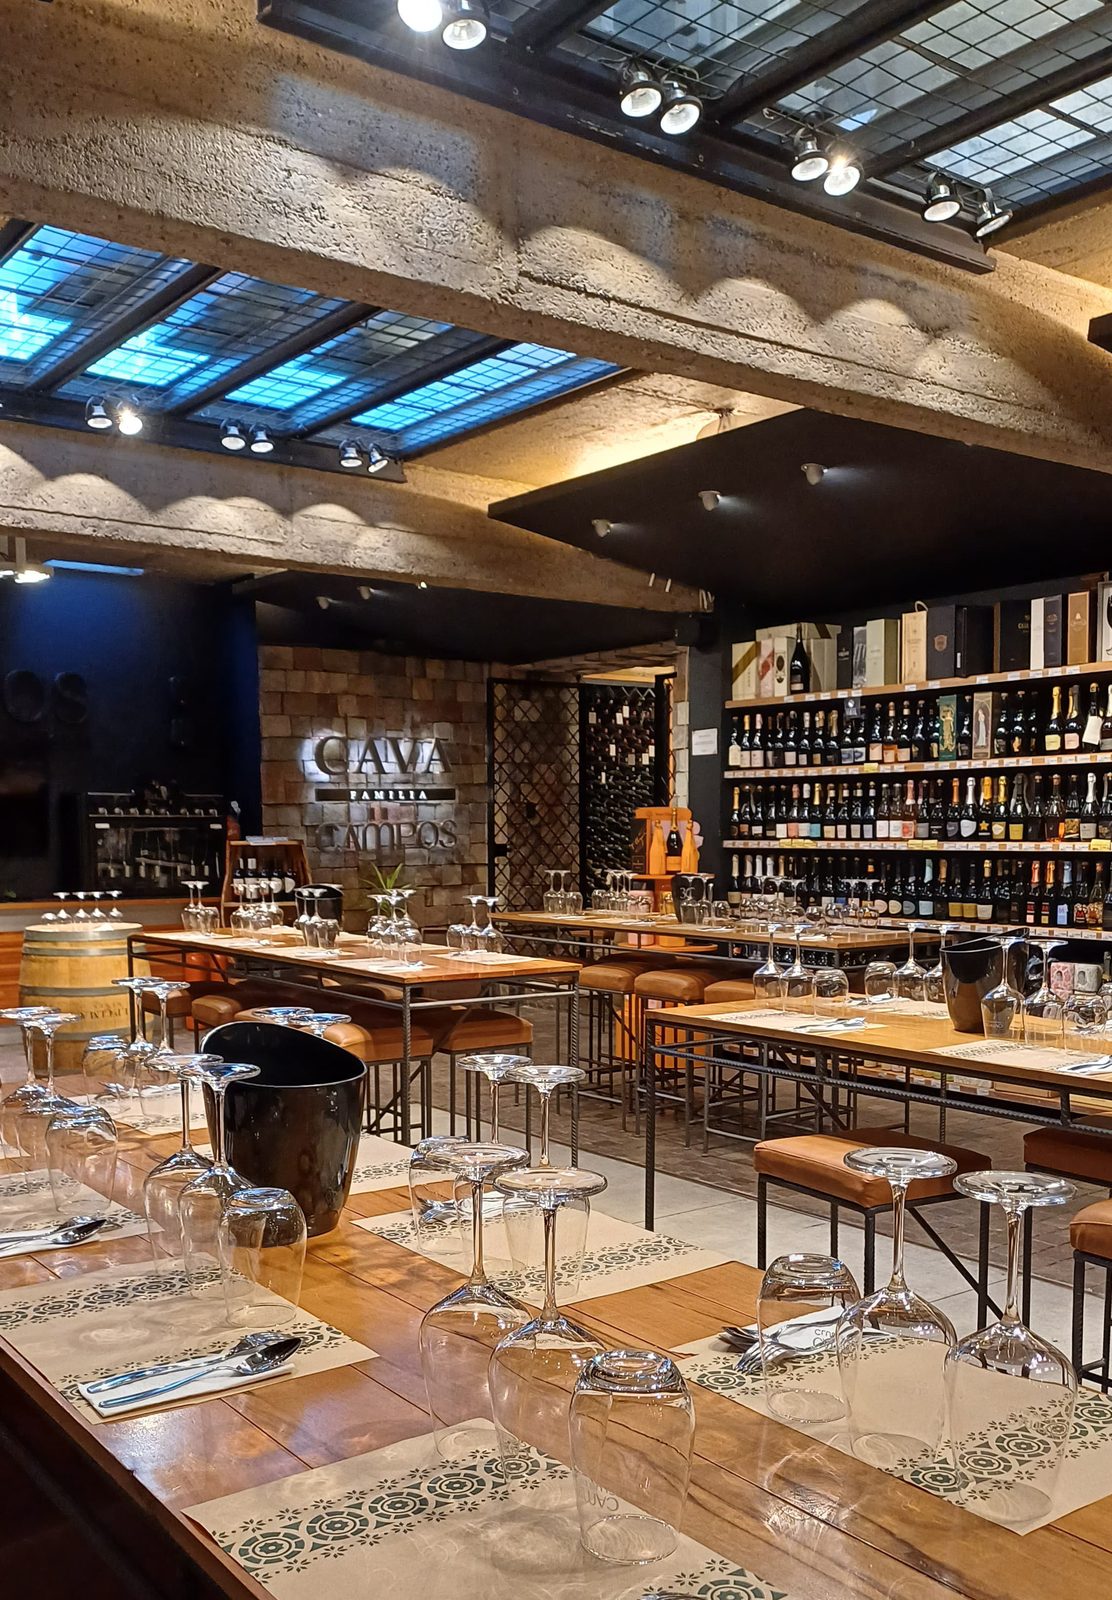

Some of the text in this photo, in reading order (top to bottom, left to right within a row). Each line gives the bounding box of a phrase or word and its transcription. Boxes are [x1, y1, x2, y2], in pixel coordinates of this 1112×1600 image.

[314, 735, 452, 775] CAVA
[349, 789, 429, 801] FAMILIA
[315, 818, 458, 853] CAMPOS
